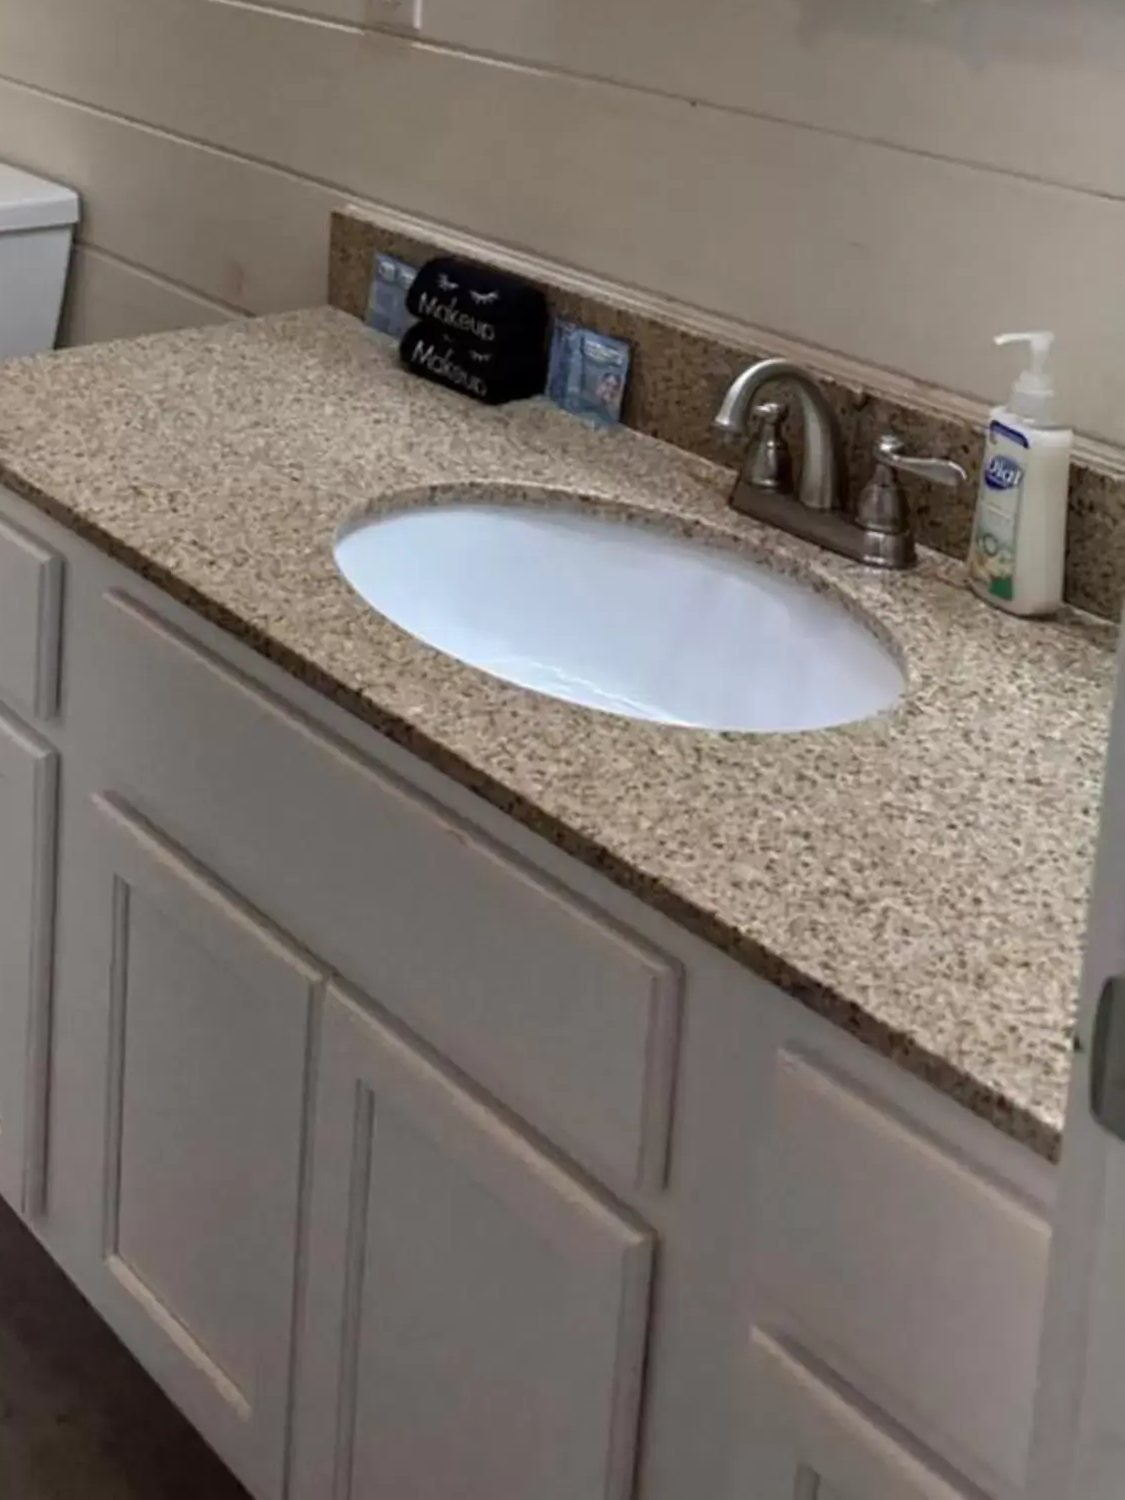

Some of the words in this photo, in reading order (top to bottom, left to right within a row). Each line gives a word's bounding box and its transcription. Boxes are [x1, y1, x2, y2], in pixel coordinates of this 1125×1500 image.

[419, 292, 495, 342] Makeup
[412, 340, 487, 396] Makeup
[987, 459, 1022, 485] Dial
